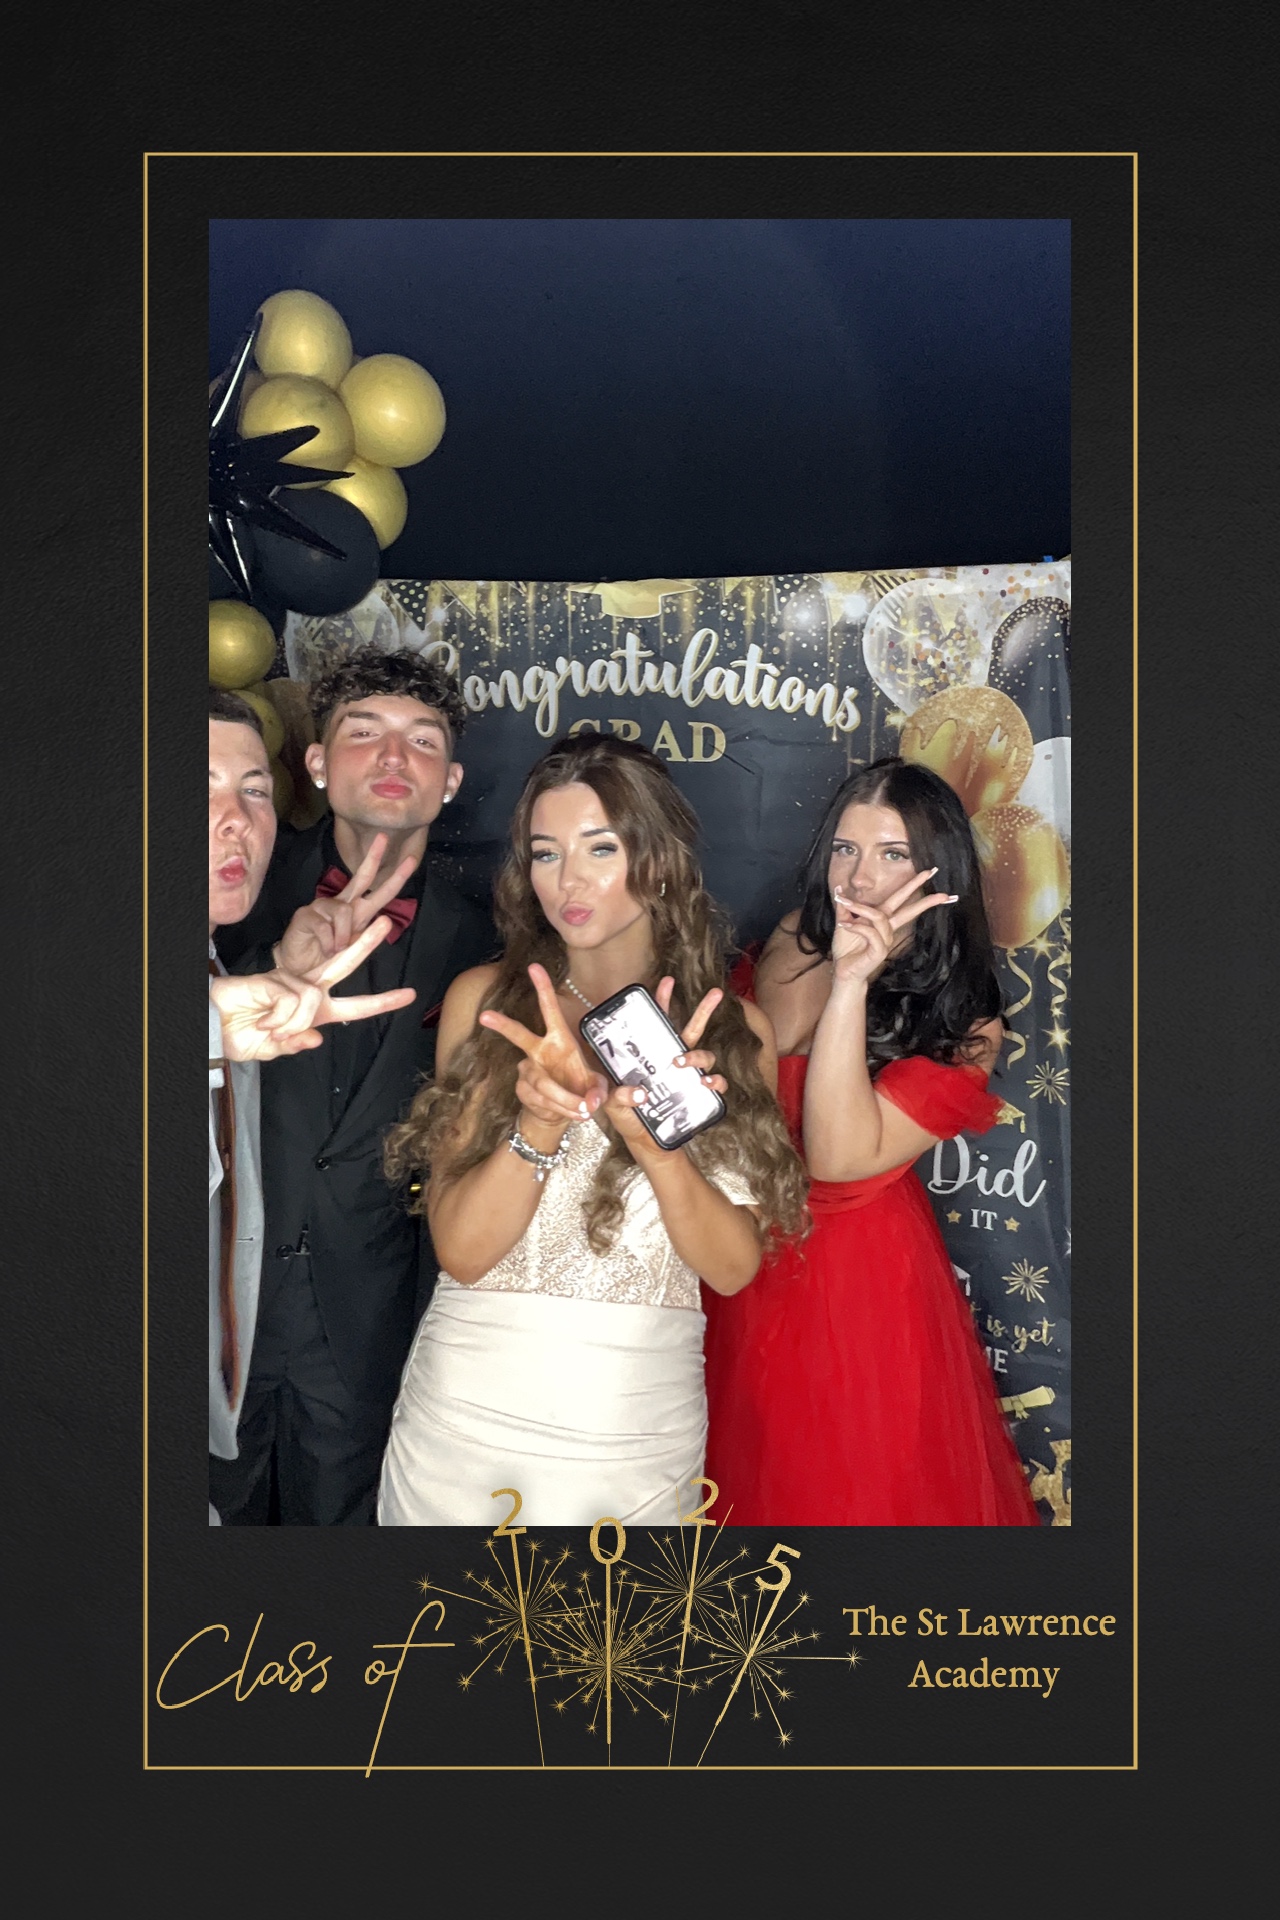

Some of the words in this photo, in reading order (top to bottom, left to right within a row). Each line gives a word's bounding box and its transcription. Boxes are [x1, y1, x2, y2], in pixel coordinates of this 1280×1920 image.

[927, 1134, 1047, 1208] Did
[970, 1208, 998, 1231] IT
[1011, 1316, 1057, 1354] yet
